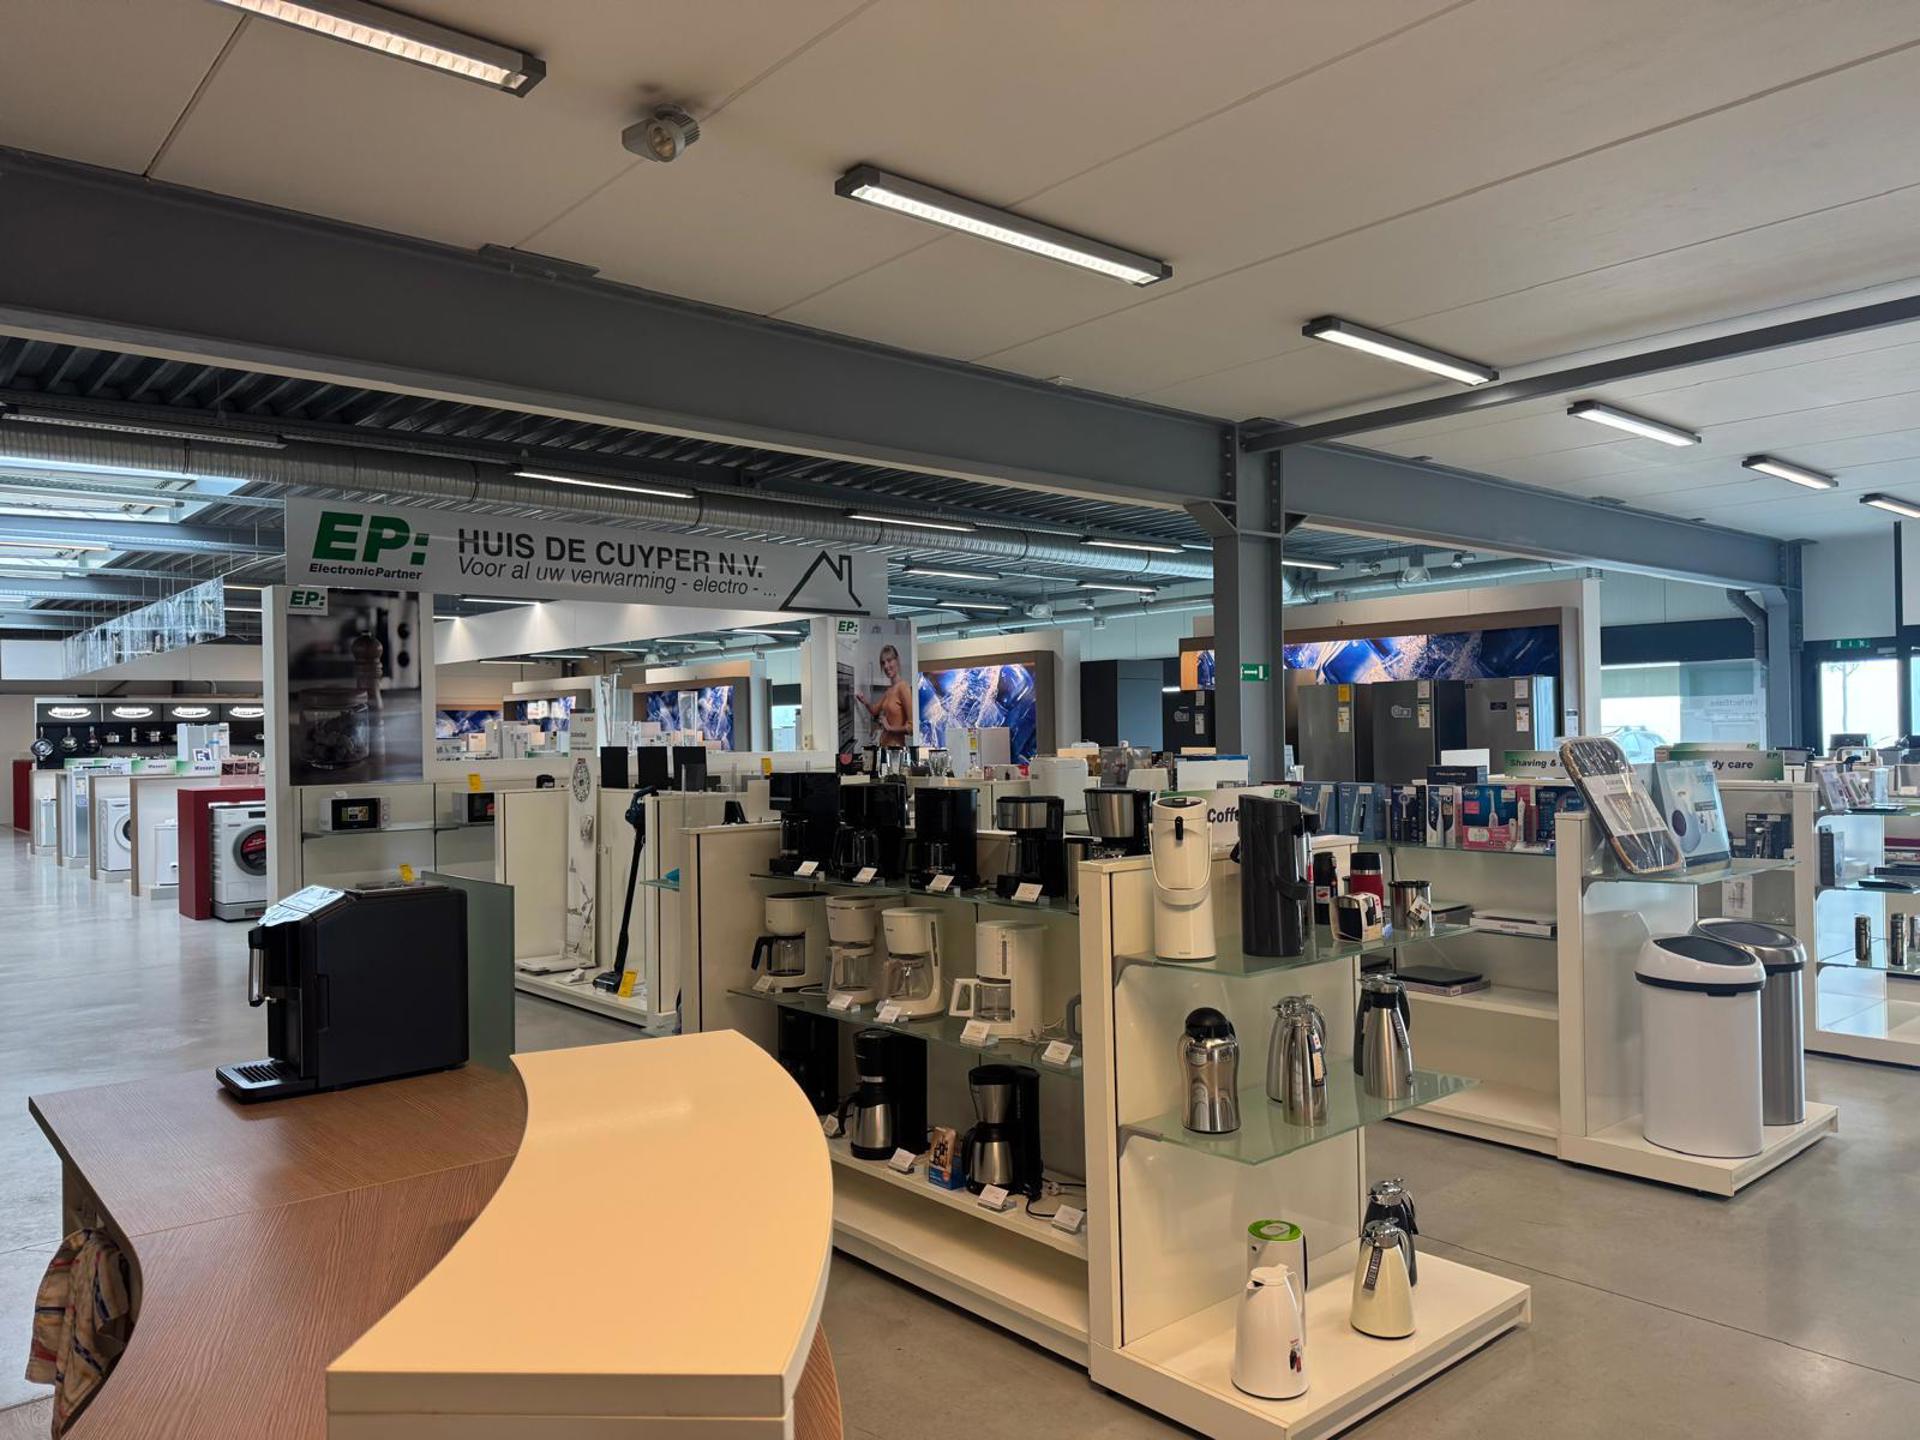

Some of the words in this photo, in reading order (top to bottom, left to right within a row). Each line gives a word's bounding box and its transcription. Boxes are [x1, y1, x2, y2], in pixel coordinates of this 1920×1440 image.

[312, 511, 430, 566] EP:
[458, 528, 535, 559] HUIS
[546, 536, 586, 563] DE
[596, 541, 710, 574] CUYPER
[719, 552, 763, 578] N.V.
[309, 563, 422, 580] ElectronicPartner
[459, 556, 507, 577] Voor
[511, 561, 530, 579] al
[536, 566, 565, 582] uw
[571, 568, 676, 594] verwarming
[693, 576, 748, 595] electro
[290, 591, 325, 606] EP:
[838, 621, 858, 632] EP:
[1510, 758, 1547, 769] Shaving
[1550, 758, 1557, 767] &
[1727, 761, 1754, 769] care
[1273, 789, 1287, 798] EP:
